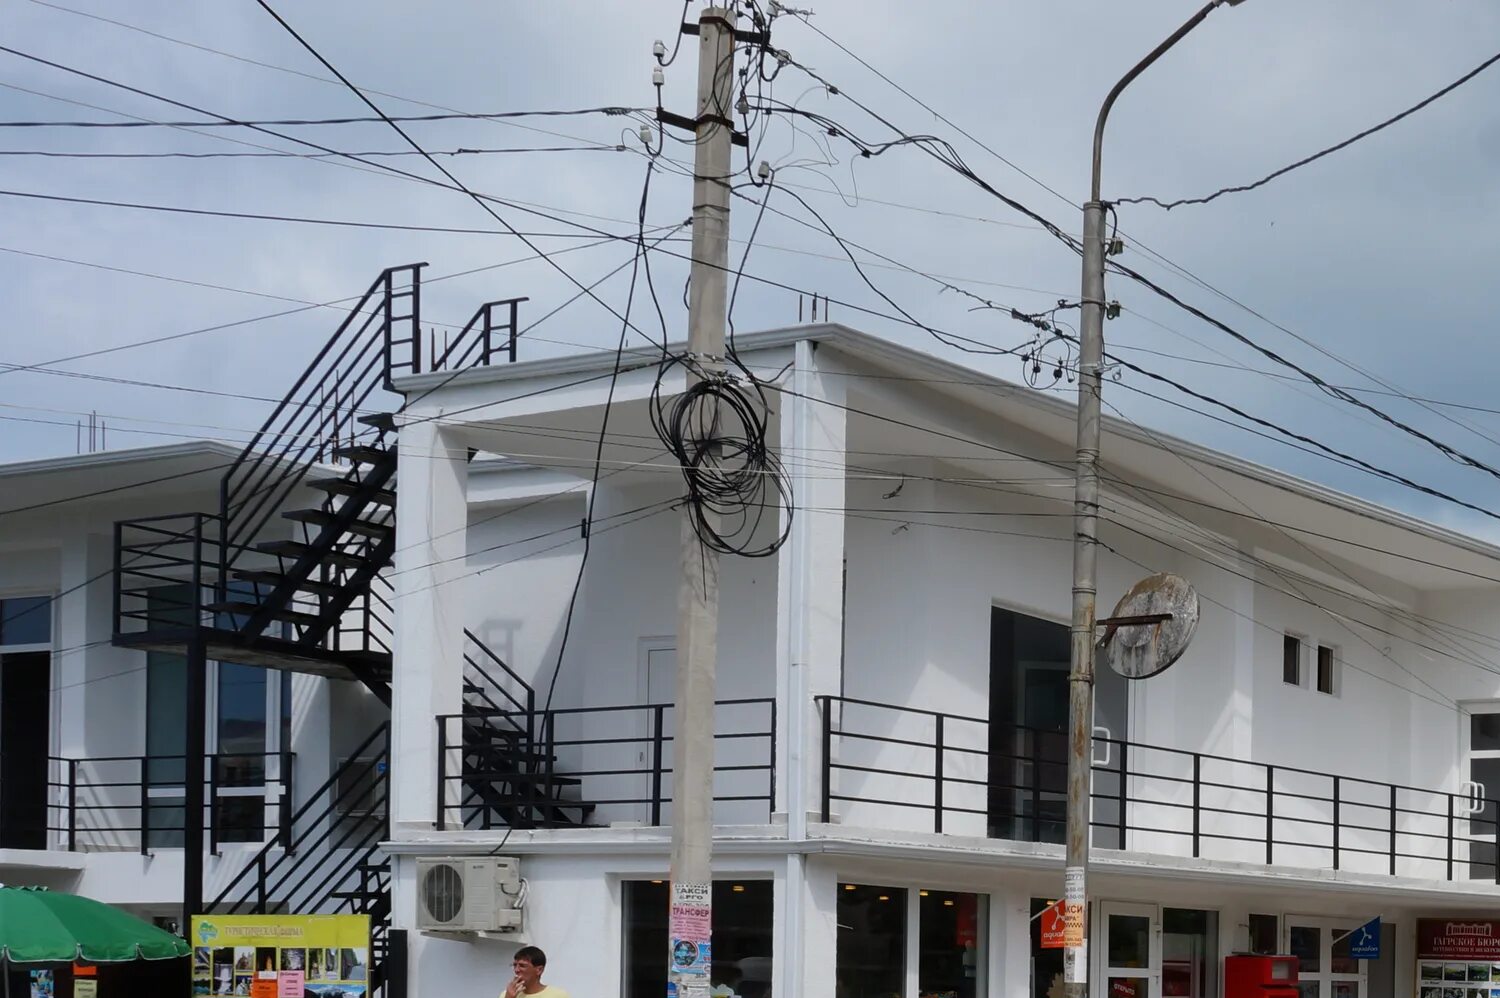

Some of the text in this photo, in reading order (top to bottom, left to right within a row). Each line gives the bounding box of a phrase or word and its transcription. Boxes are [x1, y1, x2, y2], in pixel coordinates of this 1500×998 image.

[673, 907, 709, 917] ТРАНСФЕР
[1066, 905, 1083, 914] КСИ
[1433, 937, 1476, 946] ГАГРСКОЕ
